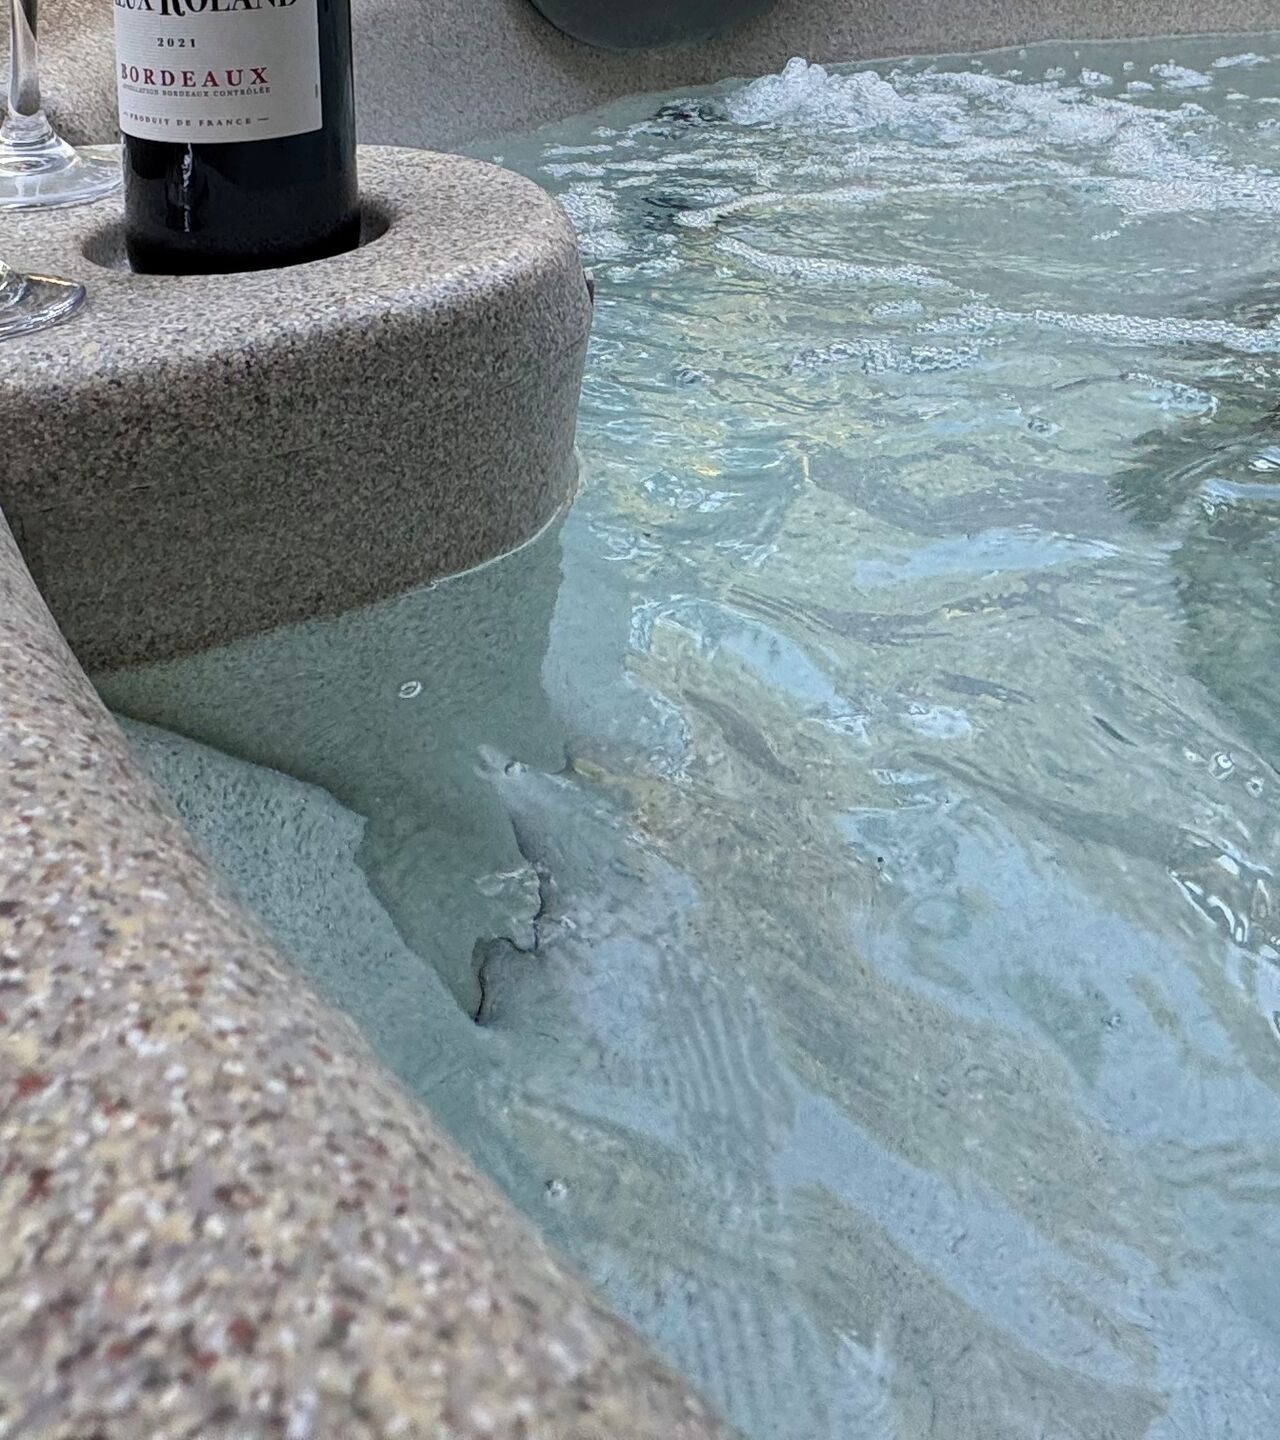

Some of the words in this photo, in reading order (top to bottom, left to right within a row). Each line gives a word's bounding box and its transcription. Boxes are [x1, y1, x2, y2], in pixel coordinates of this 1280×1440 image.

[157, 37, 196, 48] 2021
[121, 63, 268, 87] BORDEAUX
[162, 89, 209, 98] BORDEAUX
[213, 86, 271, 97] CONTRÔLÉE
[129, 112, 170, 126] PRODUIT
[176, 119, 192, 127] DE
[198, 117, 252, 127] FRANCE
